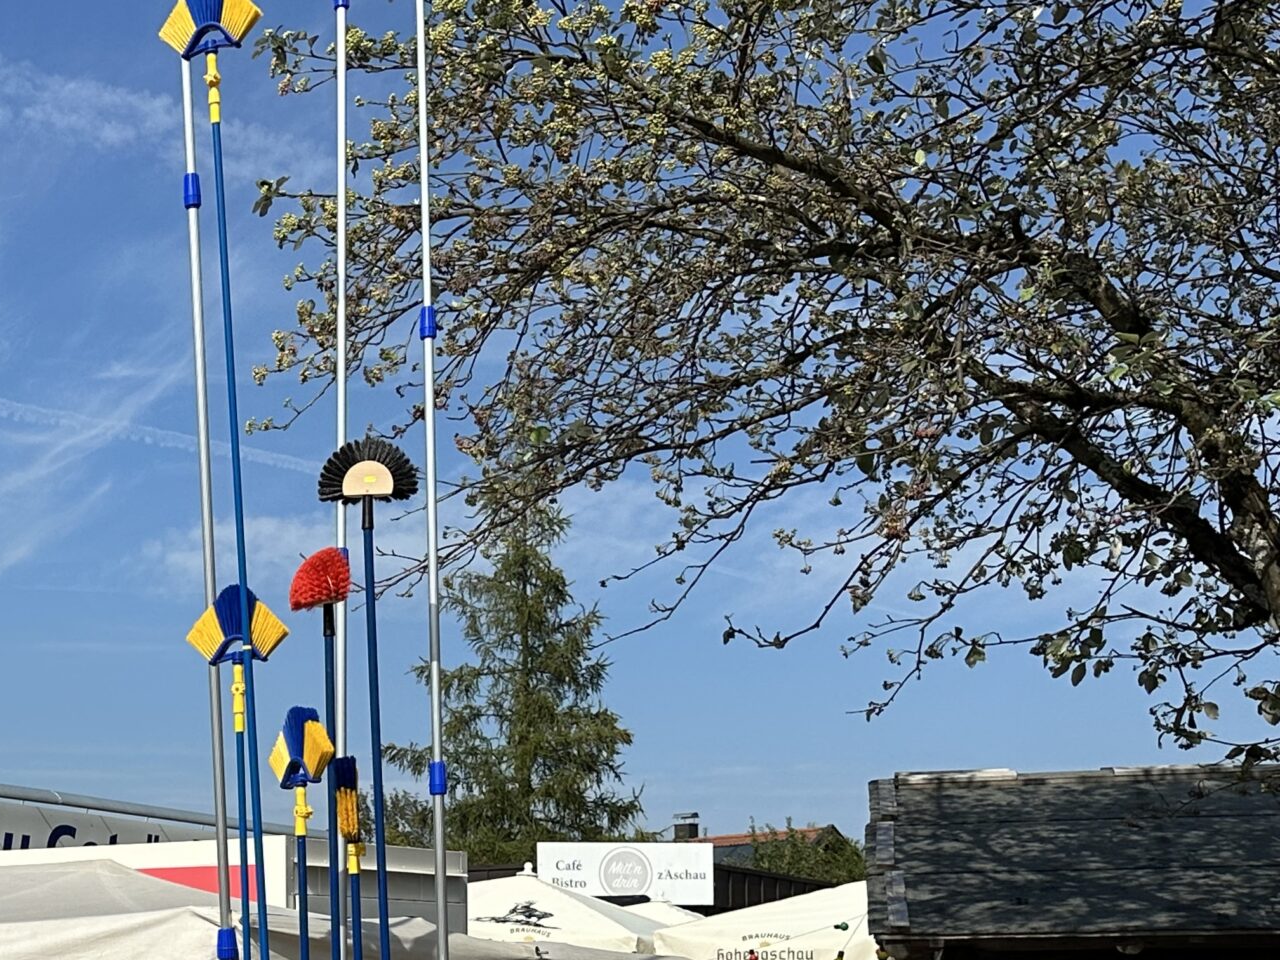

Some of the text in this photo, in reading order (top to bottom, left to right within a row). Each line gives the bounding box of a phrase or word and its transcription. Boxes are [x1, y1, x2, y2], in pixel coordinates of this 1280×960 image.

[555, 859, 582, 871] Café
[552, 877, 587, 889] Bistro
[510, 928, 551, 938] BRAUHAUS
[742, 932, 792, 942] BRAUHAUS
